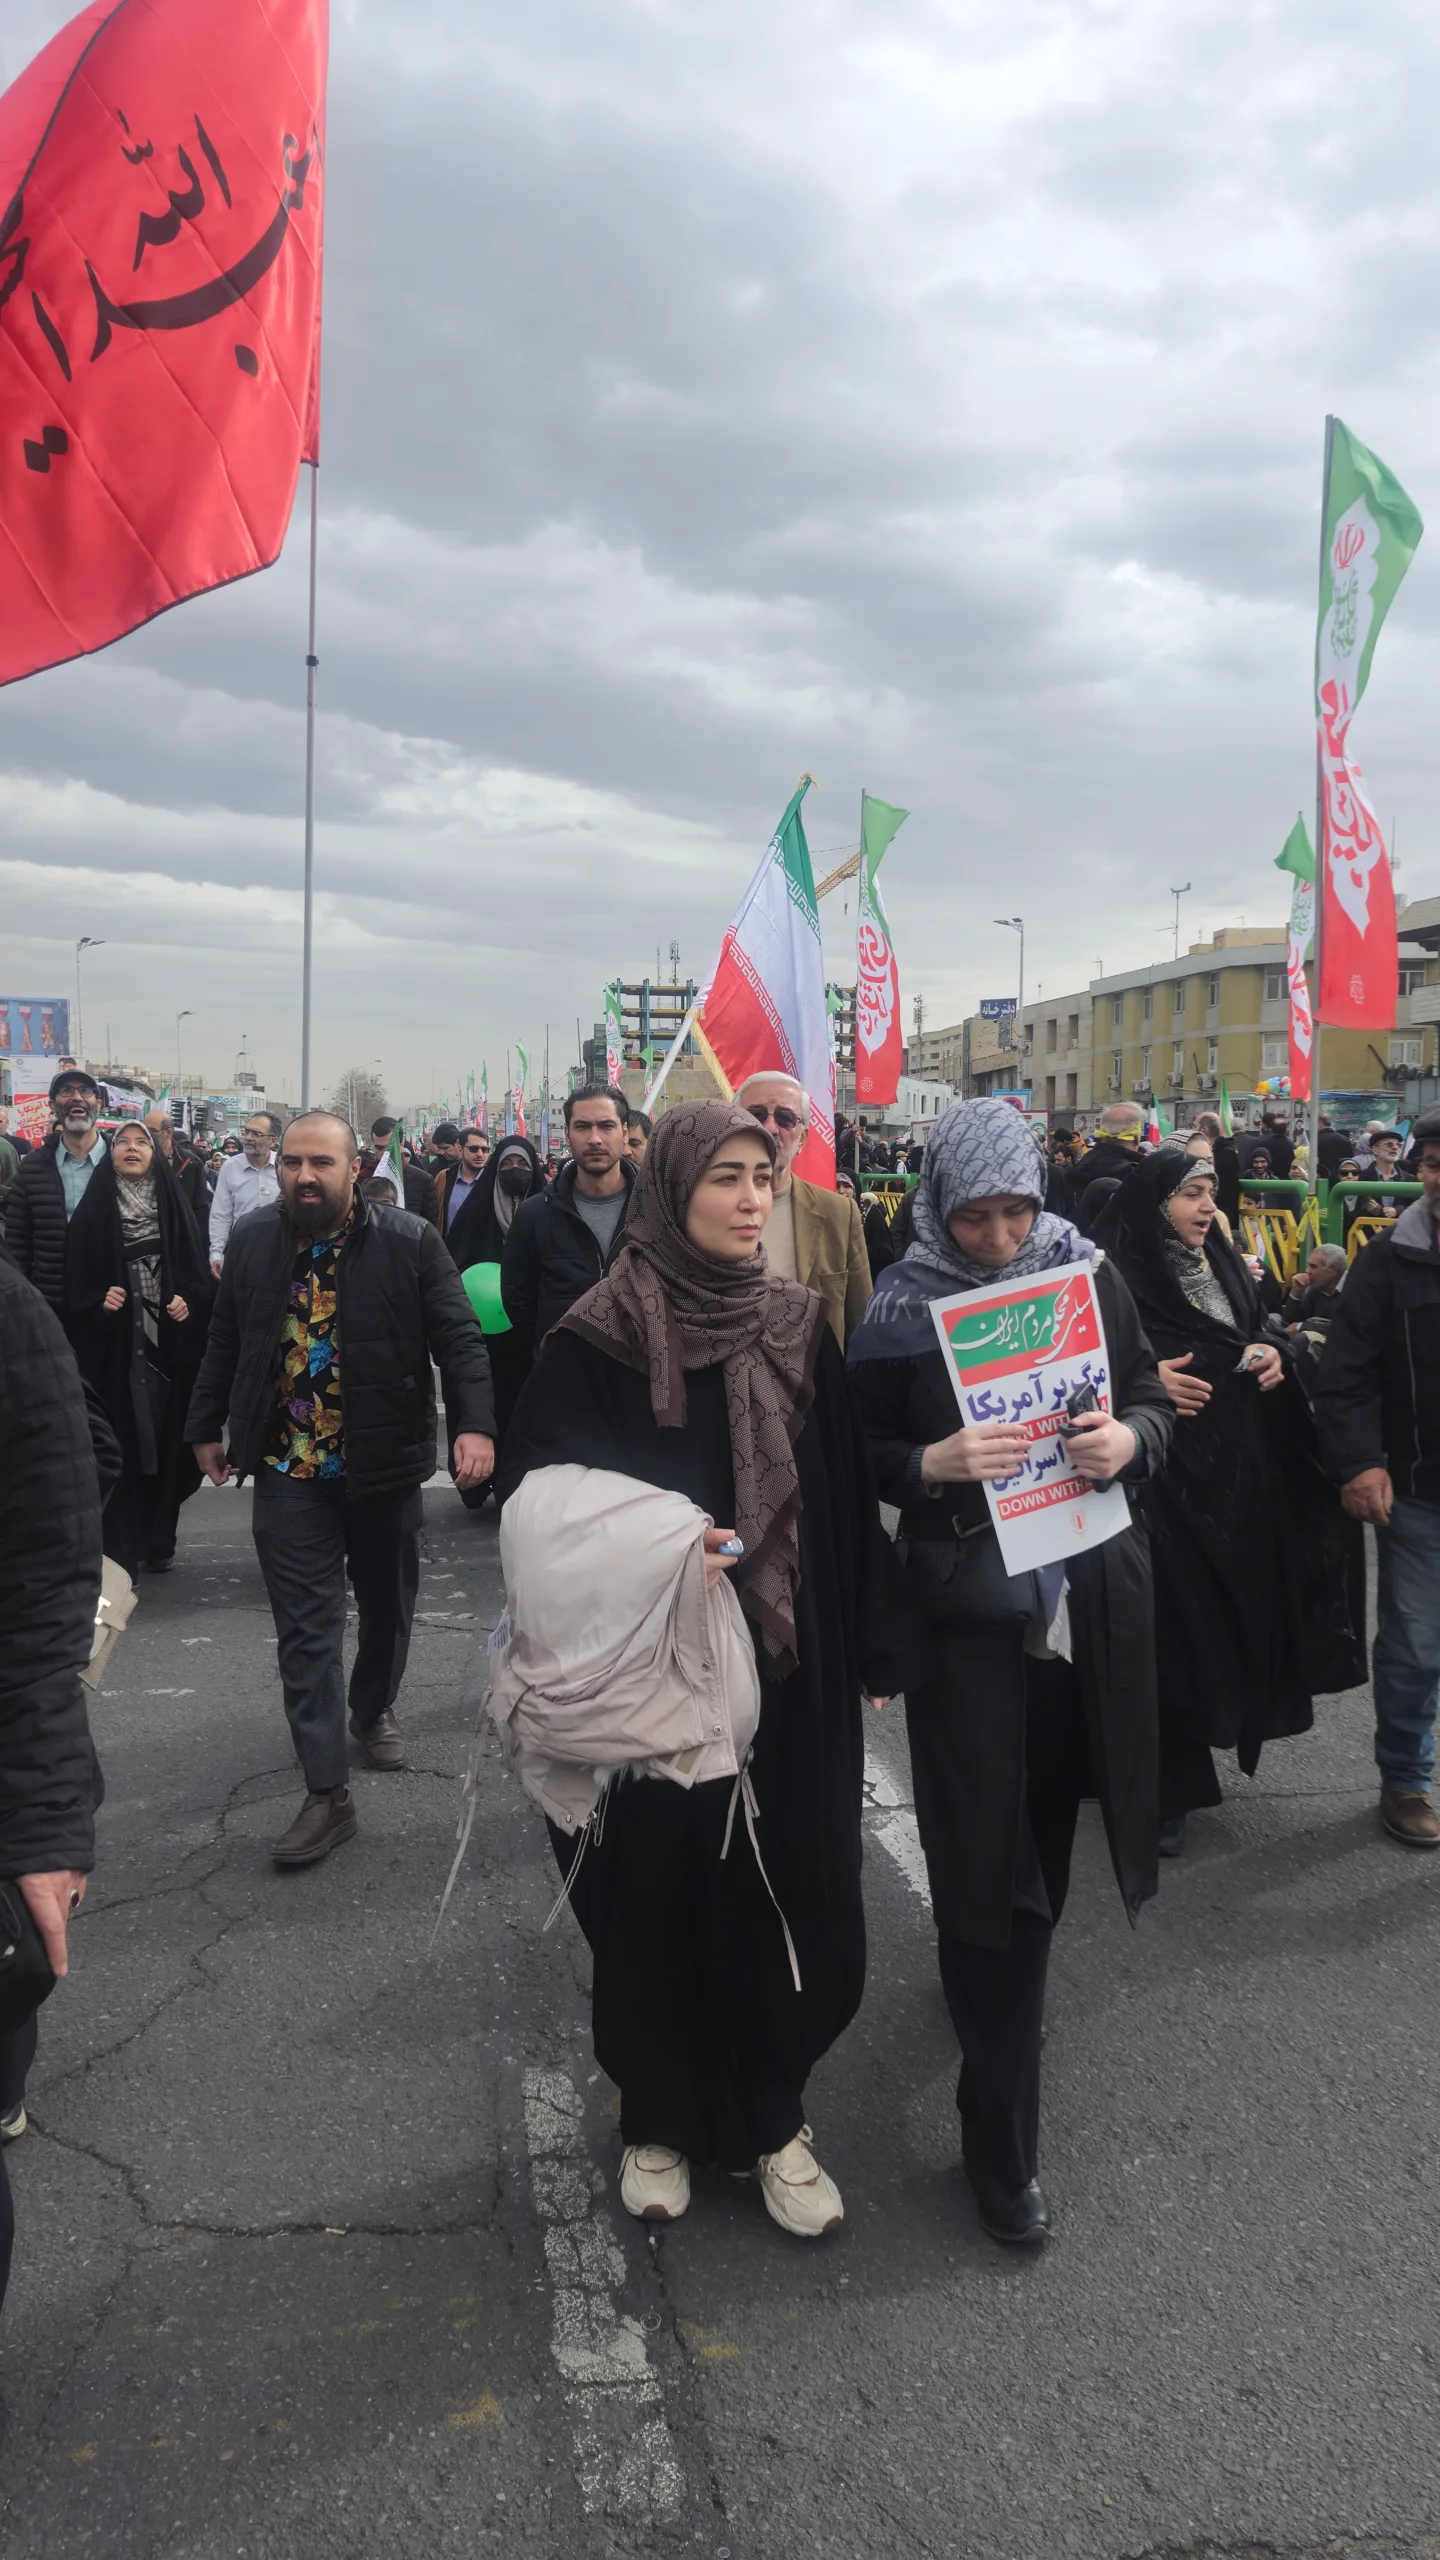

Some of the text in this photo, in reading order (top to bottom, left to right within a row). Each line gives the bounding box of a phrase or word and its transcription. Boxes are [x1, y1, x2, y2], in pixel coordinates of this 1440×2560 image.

[950, 1276, 1092, 1364] سیلی محکم مردم ایران
[966, 1370, 1043, 1424] آمریکا
[1050, 1378, 1068, 1411] بر
[999, 1490, 1047, 1517] DOWN
[1048, 1479, 1084, 1500] WITH
